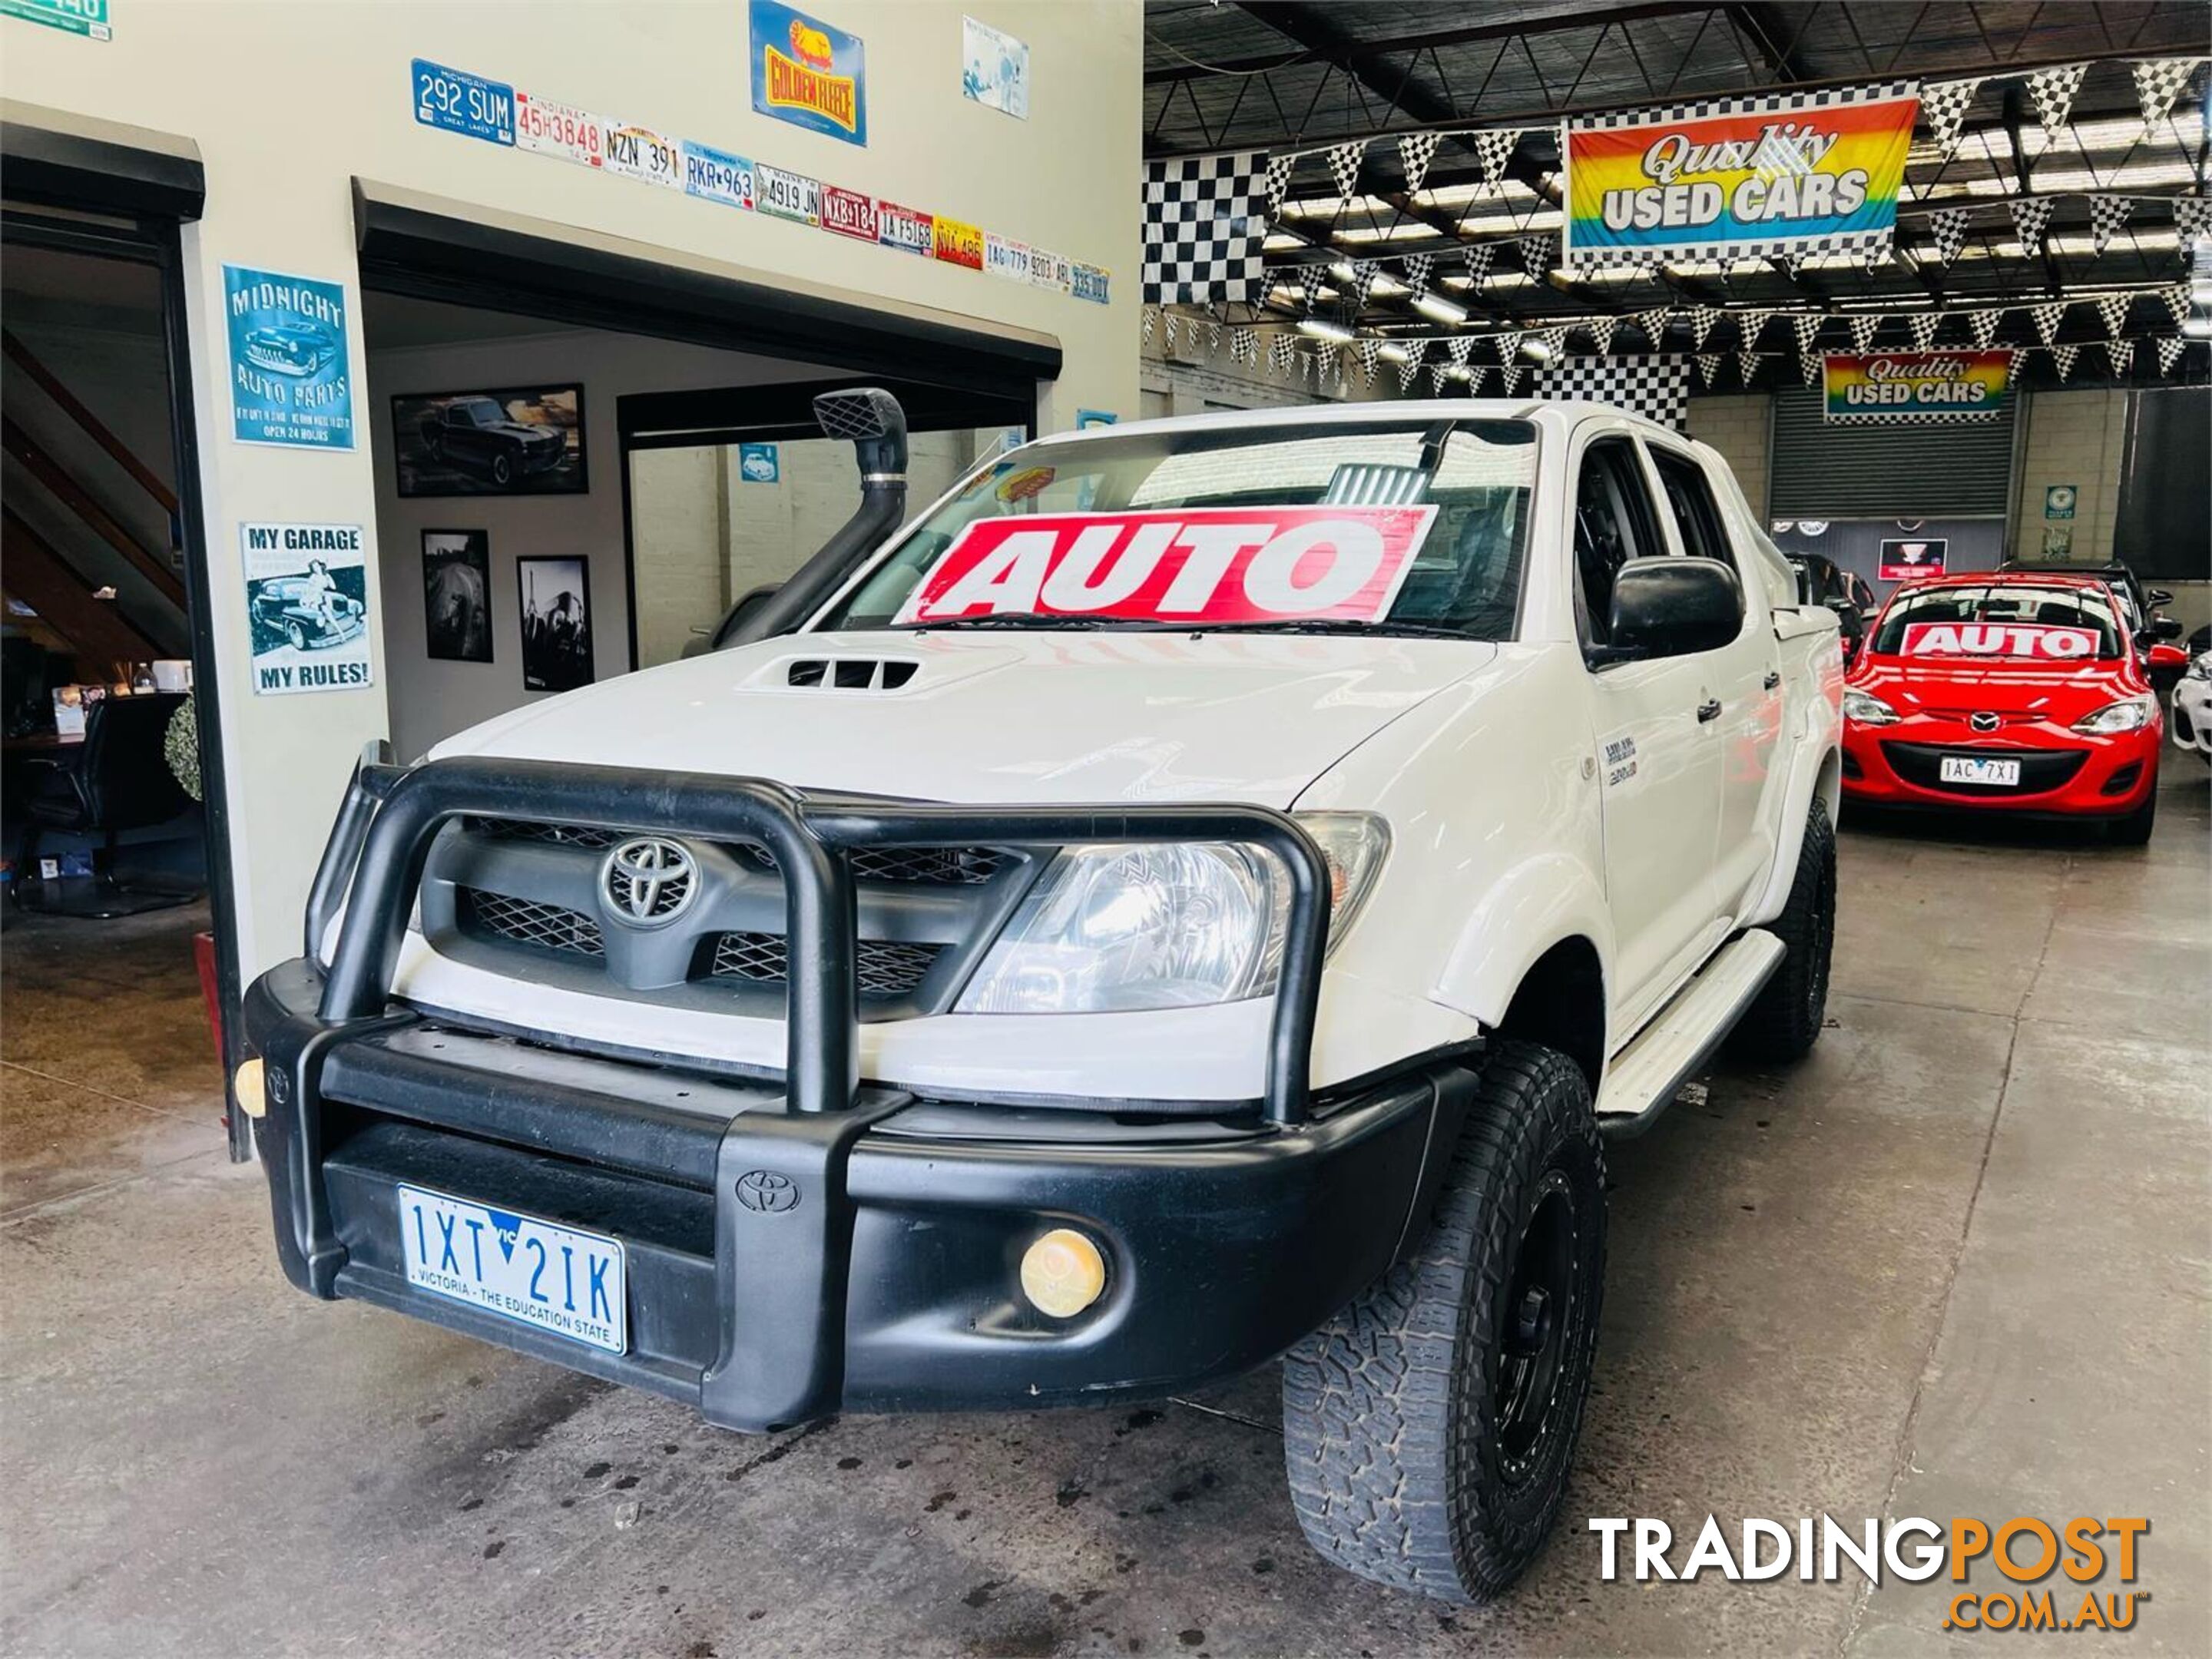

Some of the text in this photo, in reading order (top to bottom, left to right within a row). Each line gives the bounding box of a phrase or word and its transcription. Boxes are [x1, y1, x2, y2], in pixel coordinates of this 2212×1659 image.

[420, 74, 509, 130] 292 SUM
[440, 70, 488, 91] MICHIGAN
[770, 55, 852, 126] GOLDEN FLEECE
[519, 106, 599, 153] 45H3848
[607, 129, 638, 167] NZN
[648, 143, 677, 177] 391
[1641, 122, 1841, 185] Quality
[687, 157, 716, 189] RKR
[724, 167, 751, 198] 963
[769, 179, 800, 210] 4919
[804, 189, 818, 215] JN
[823, 192, 849, 224] NXB
[853, 203, 877, 233] 184
[1603, 168, 1870, 232] USED CARS
[232, 283, 342, 329] MIDNIGHT
[237, 363, 346, 409] AUTO PARTS
[1866, 356, 1972, 383] Quality
[1846, 382, 1986, 406] USED CARS
[288, 427, 299, 439] 24
[249, 528, 359, 550] MY GARAGE
[922, 520, 1383, 617] AUTO
[1912, 626, 2091, 657] AUTO
[260, 663, 369, 689] MY RULES!
[496, 1228, 517, 1245] VIC
[413, 1205, 611, 1323] 1XT 2IK
[419, 1270, 469, 1296] VICTORIA
[480, 1288, 502, 1306] THE
[505, 1296, 571, 1329] EDUCATION
[575, 1320, 610, 1343] STATE
